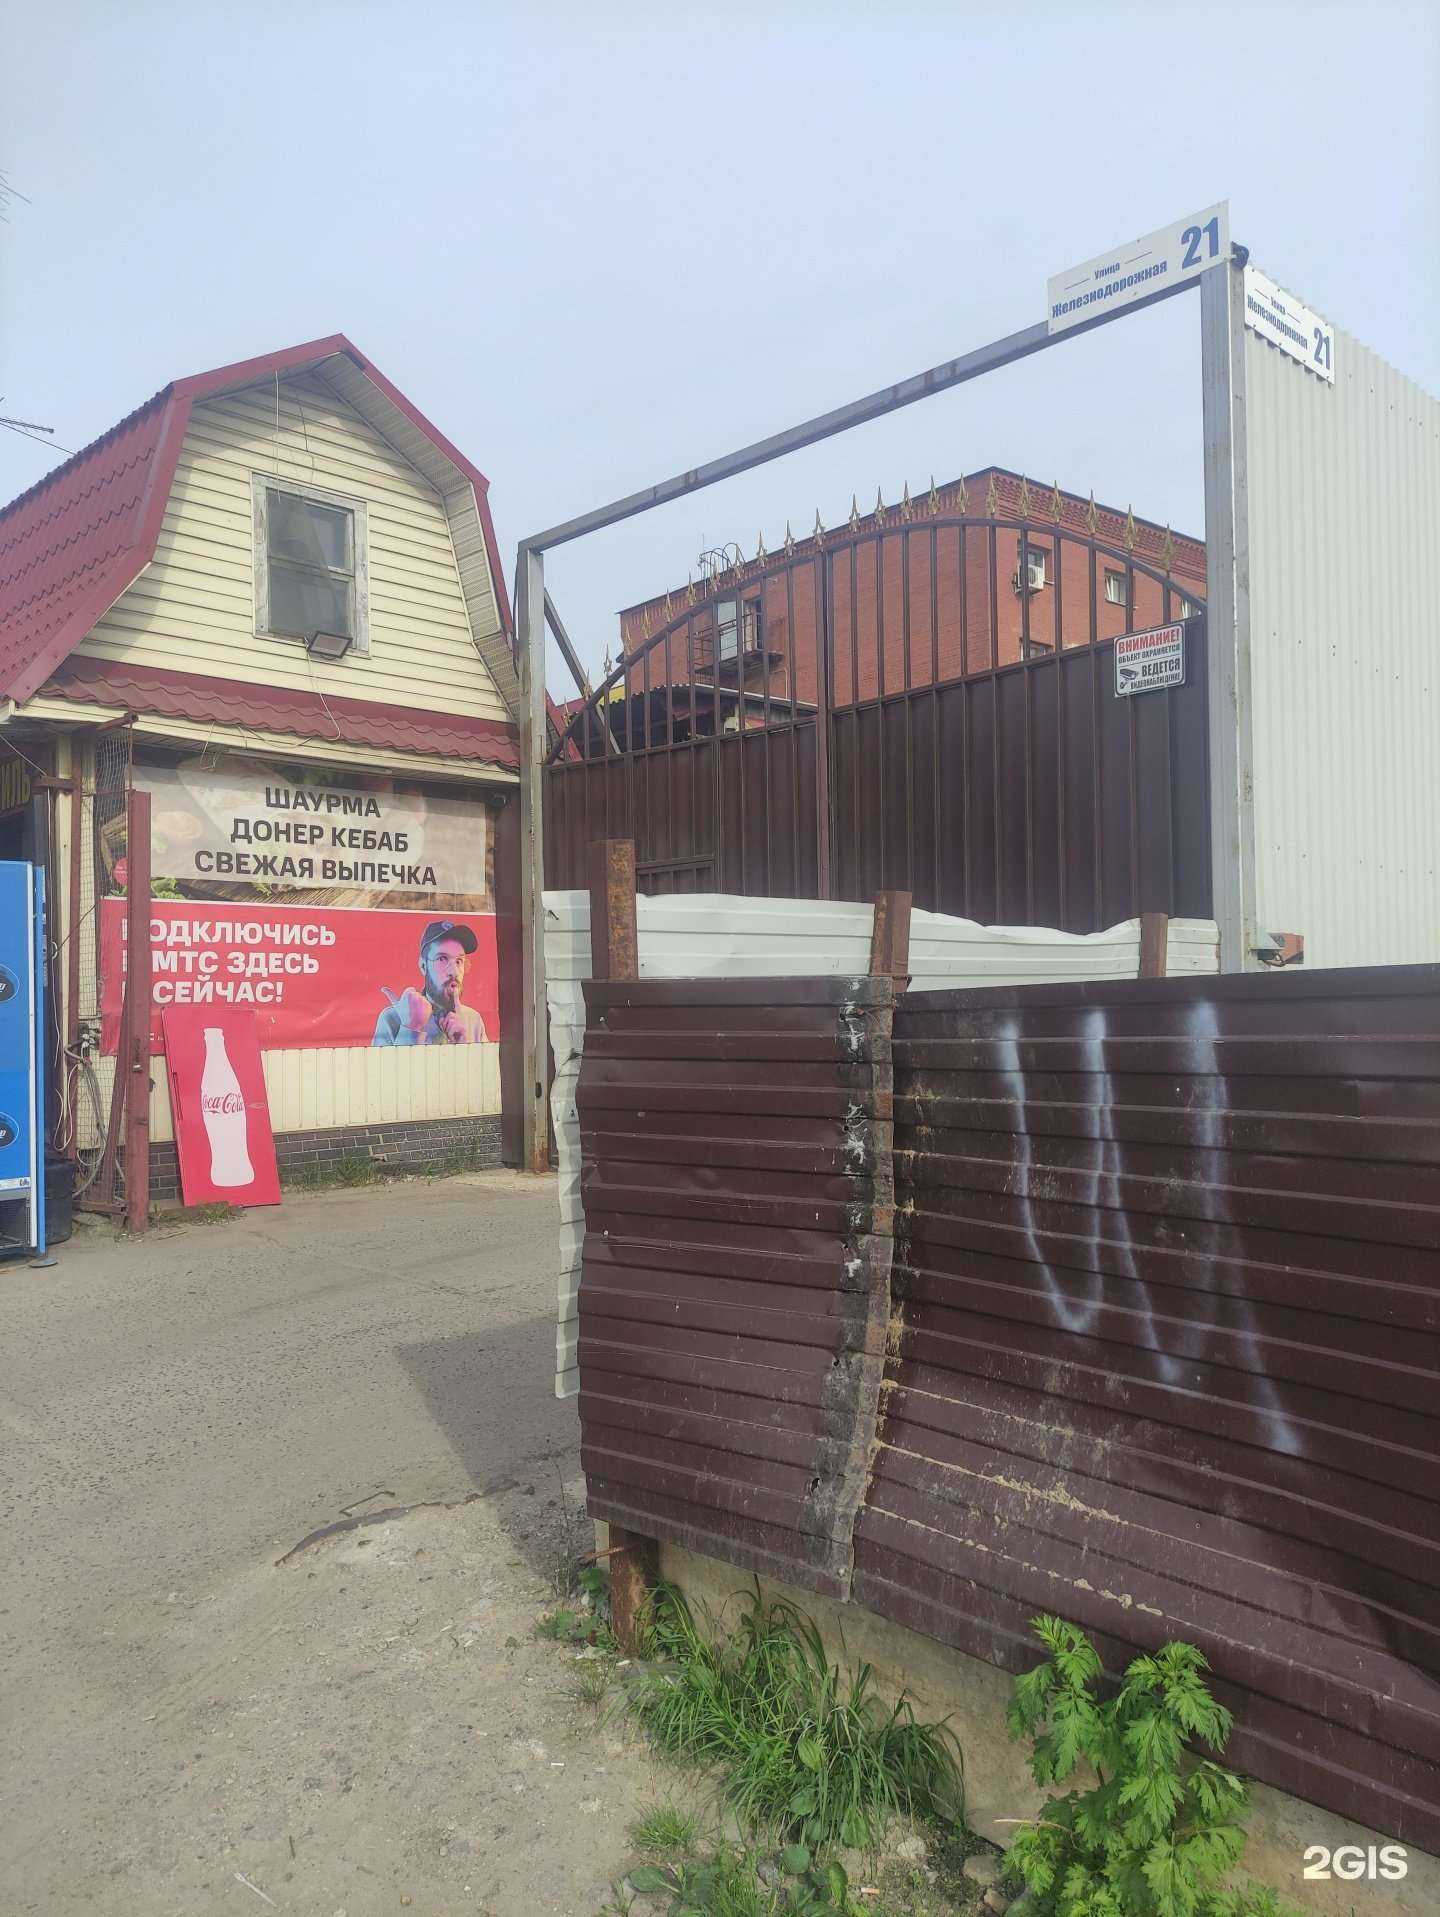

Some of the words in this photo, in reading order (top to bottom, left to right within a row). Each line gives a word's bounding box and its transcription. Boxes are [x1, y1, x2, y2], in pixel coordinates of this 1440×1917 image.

[1181, 216, 1220, 270] 21
[1094, 261, 1121, 281] Улица
[1052, 260, 1168, 318] Железнодорожная
[1247, 294, 1308, 350] Железнодорожная
[1313, 327, 1330, 370] 21
[1118, 628, 1180, 654] ВНИМАНИЕ!
[1141, 657, 1181, 677] ВЕДЕТСЯ
[265, 787, 381, 818] ШАУРМА
[230, 818, 324, 844] ДОНЕР
[331, 827, 409, 853] КЕБАБ
[194, 850, 314, 878] СВЕЖАЯ
[322, 859, 437, 886] ВЫПЕЧКА
[122, 918, 337, 947] ОДКЛЮЧИСЬ
[152, 950, 219, 973] МТС
[227, 951, 319, 978] ЗДЕСЬ
[152, 974, 284, 1003] СЕЙЧАС!
[202, 1092, 243, 1114] oca-Cola
